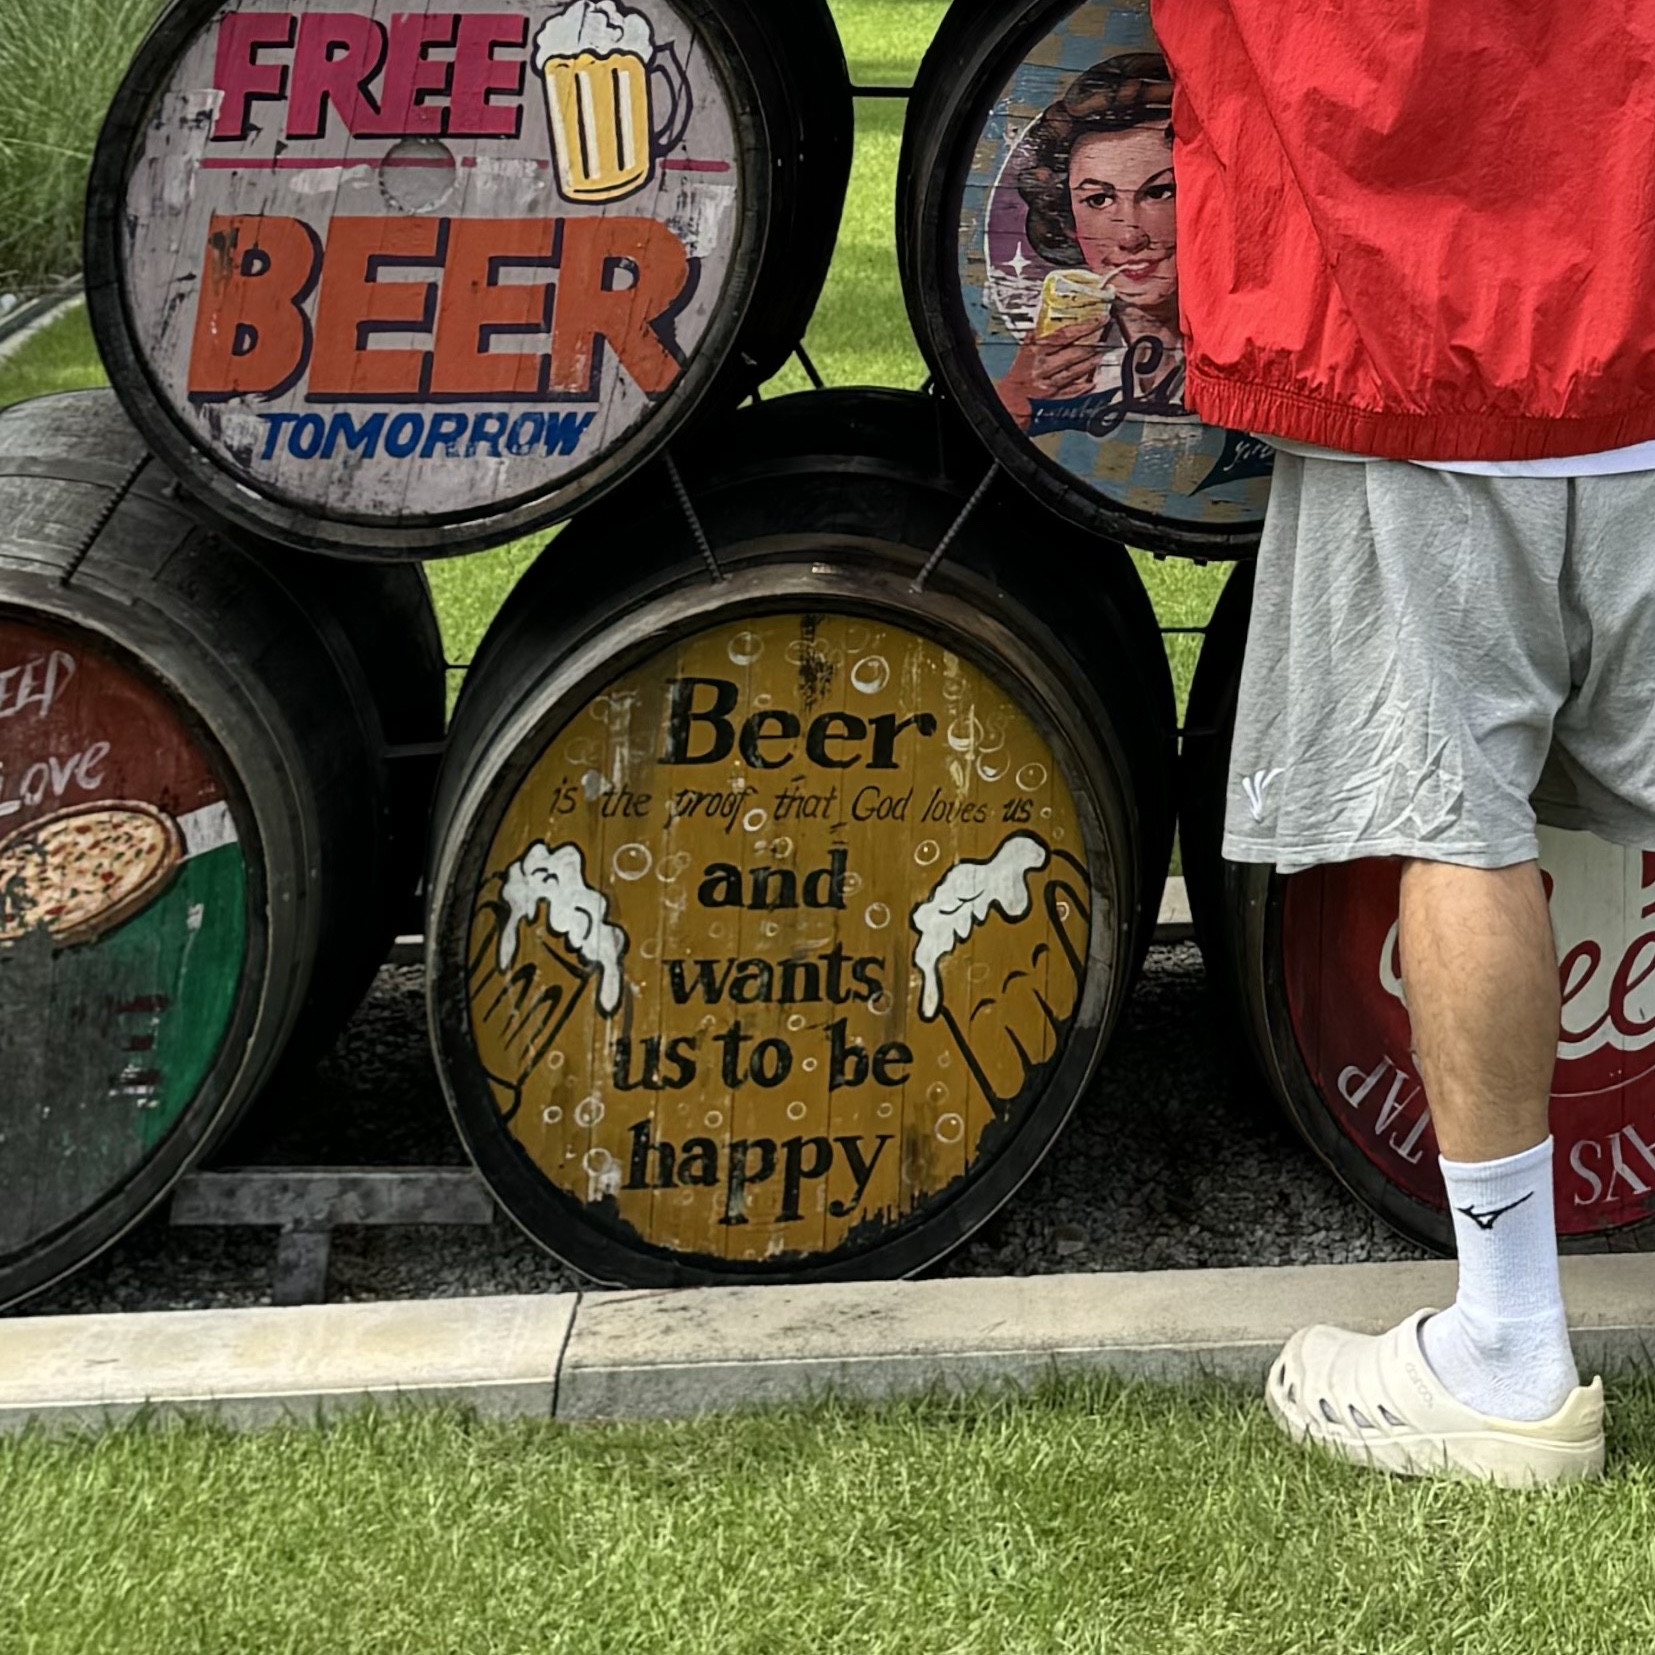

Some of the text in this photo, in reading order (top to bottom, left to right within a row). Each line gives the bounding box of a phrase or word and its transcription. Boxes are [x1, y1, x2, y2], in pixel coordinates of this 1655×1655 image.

[211, 12, 531, 142] FREE
[187, 215, 701, 404] BEER
[257, 411, 600, 461] TOMORROW
[657, 677, 938, 770] Beer
[549, 777, 1034, 835] is the proof that God loves us
[697, 845, 848, 911] and
[661, 940, 886, 1006] wants
[608, 1018, 915, 1092] us to be
[619, 1119, 895, 1226] happy
